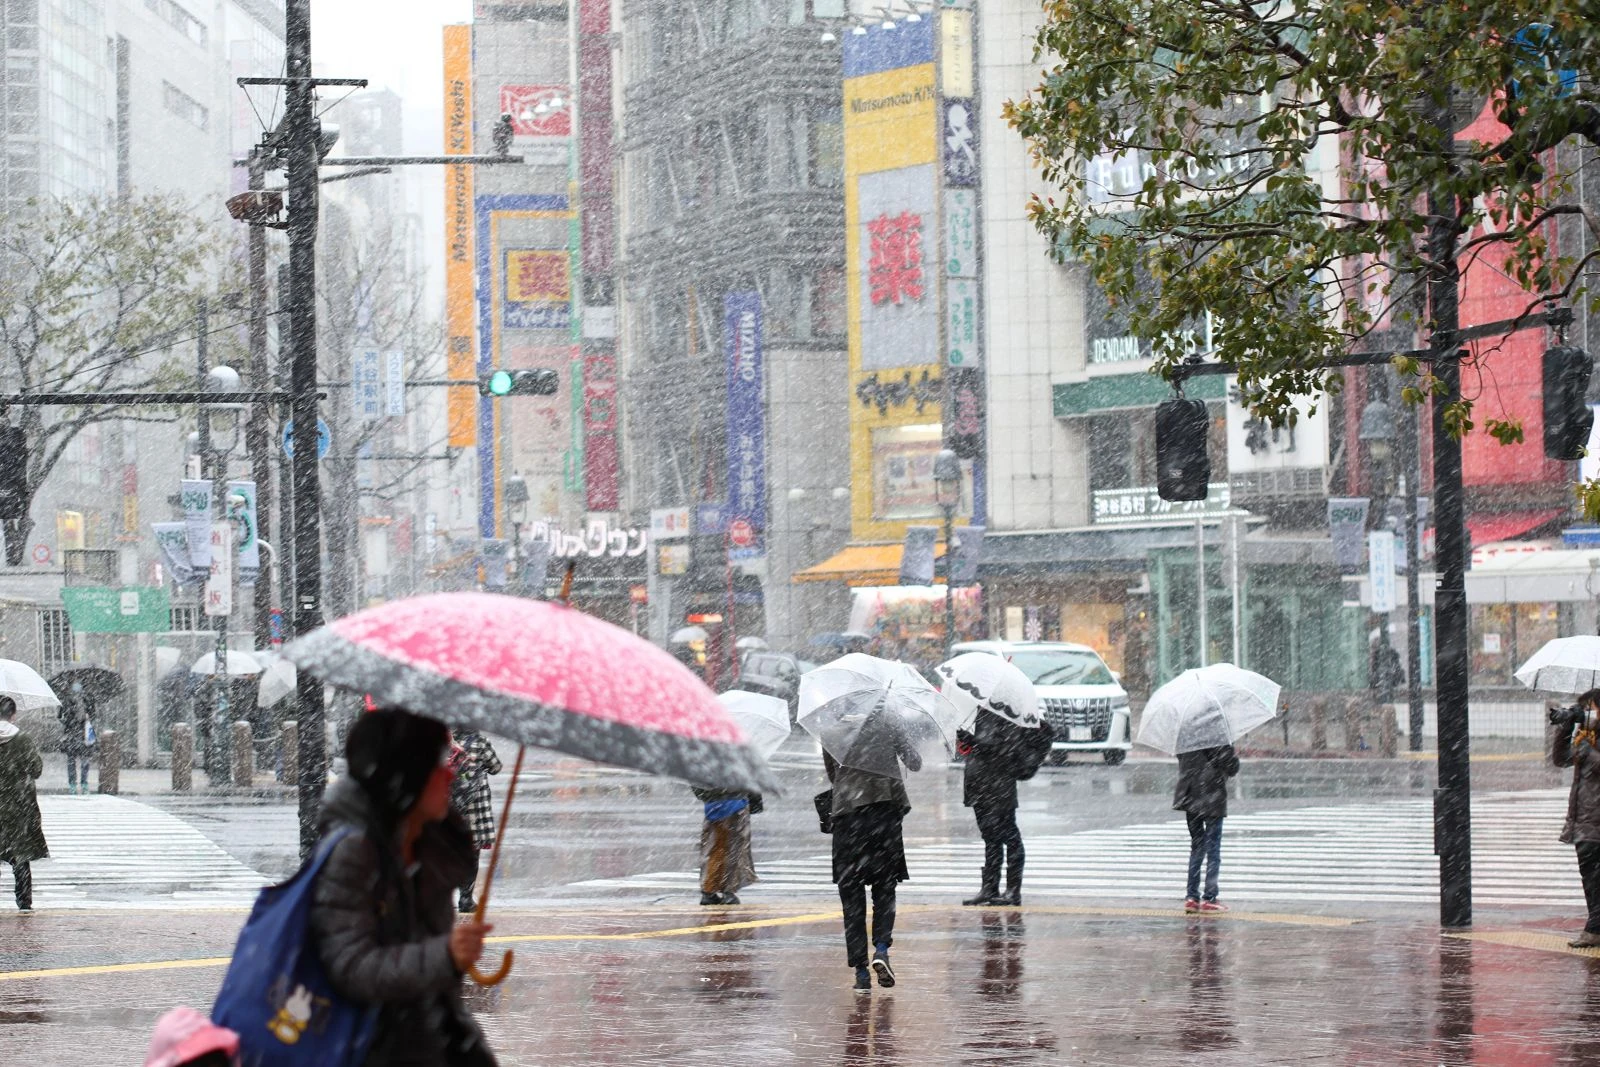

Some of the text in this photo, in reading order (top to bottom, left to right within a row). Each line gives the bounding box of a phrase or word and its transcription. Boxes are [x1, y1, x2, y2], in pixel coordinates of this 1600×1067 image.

[451, 164, 467, 263] Matsumot
[740, 311, 755, 381] MIZUHO
[1094, 337, 1139, 363] DENDAMA
[364, 351, 378, 413] 渋谷駅前
[1096, 496, 1145, 515] 渋谷西村
